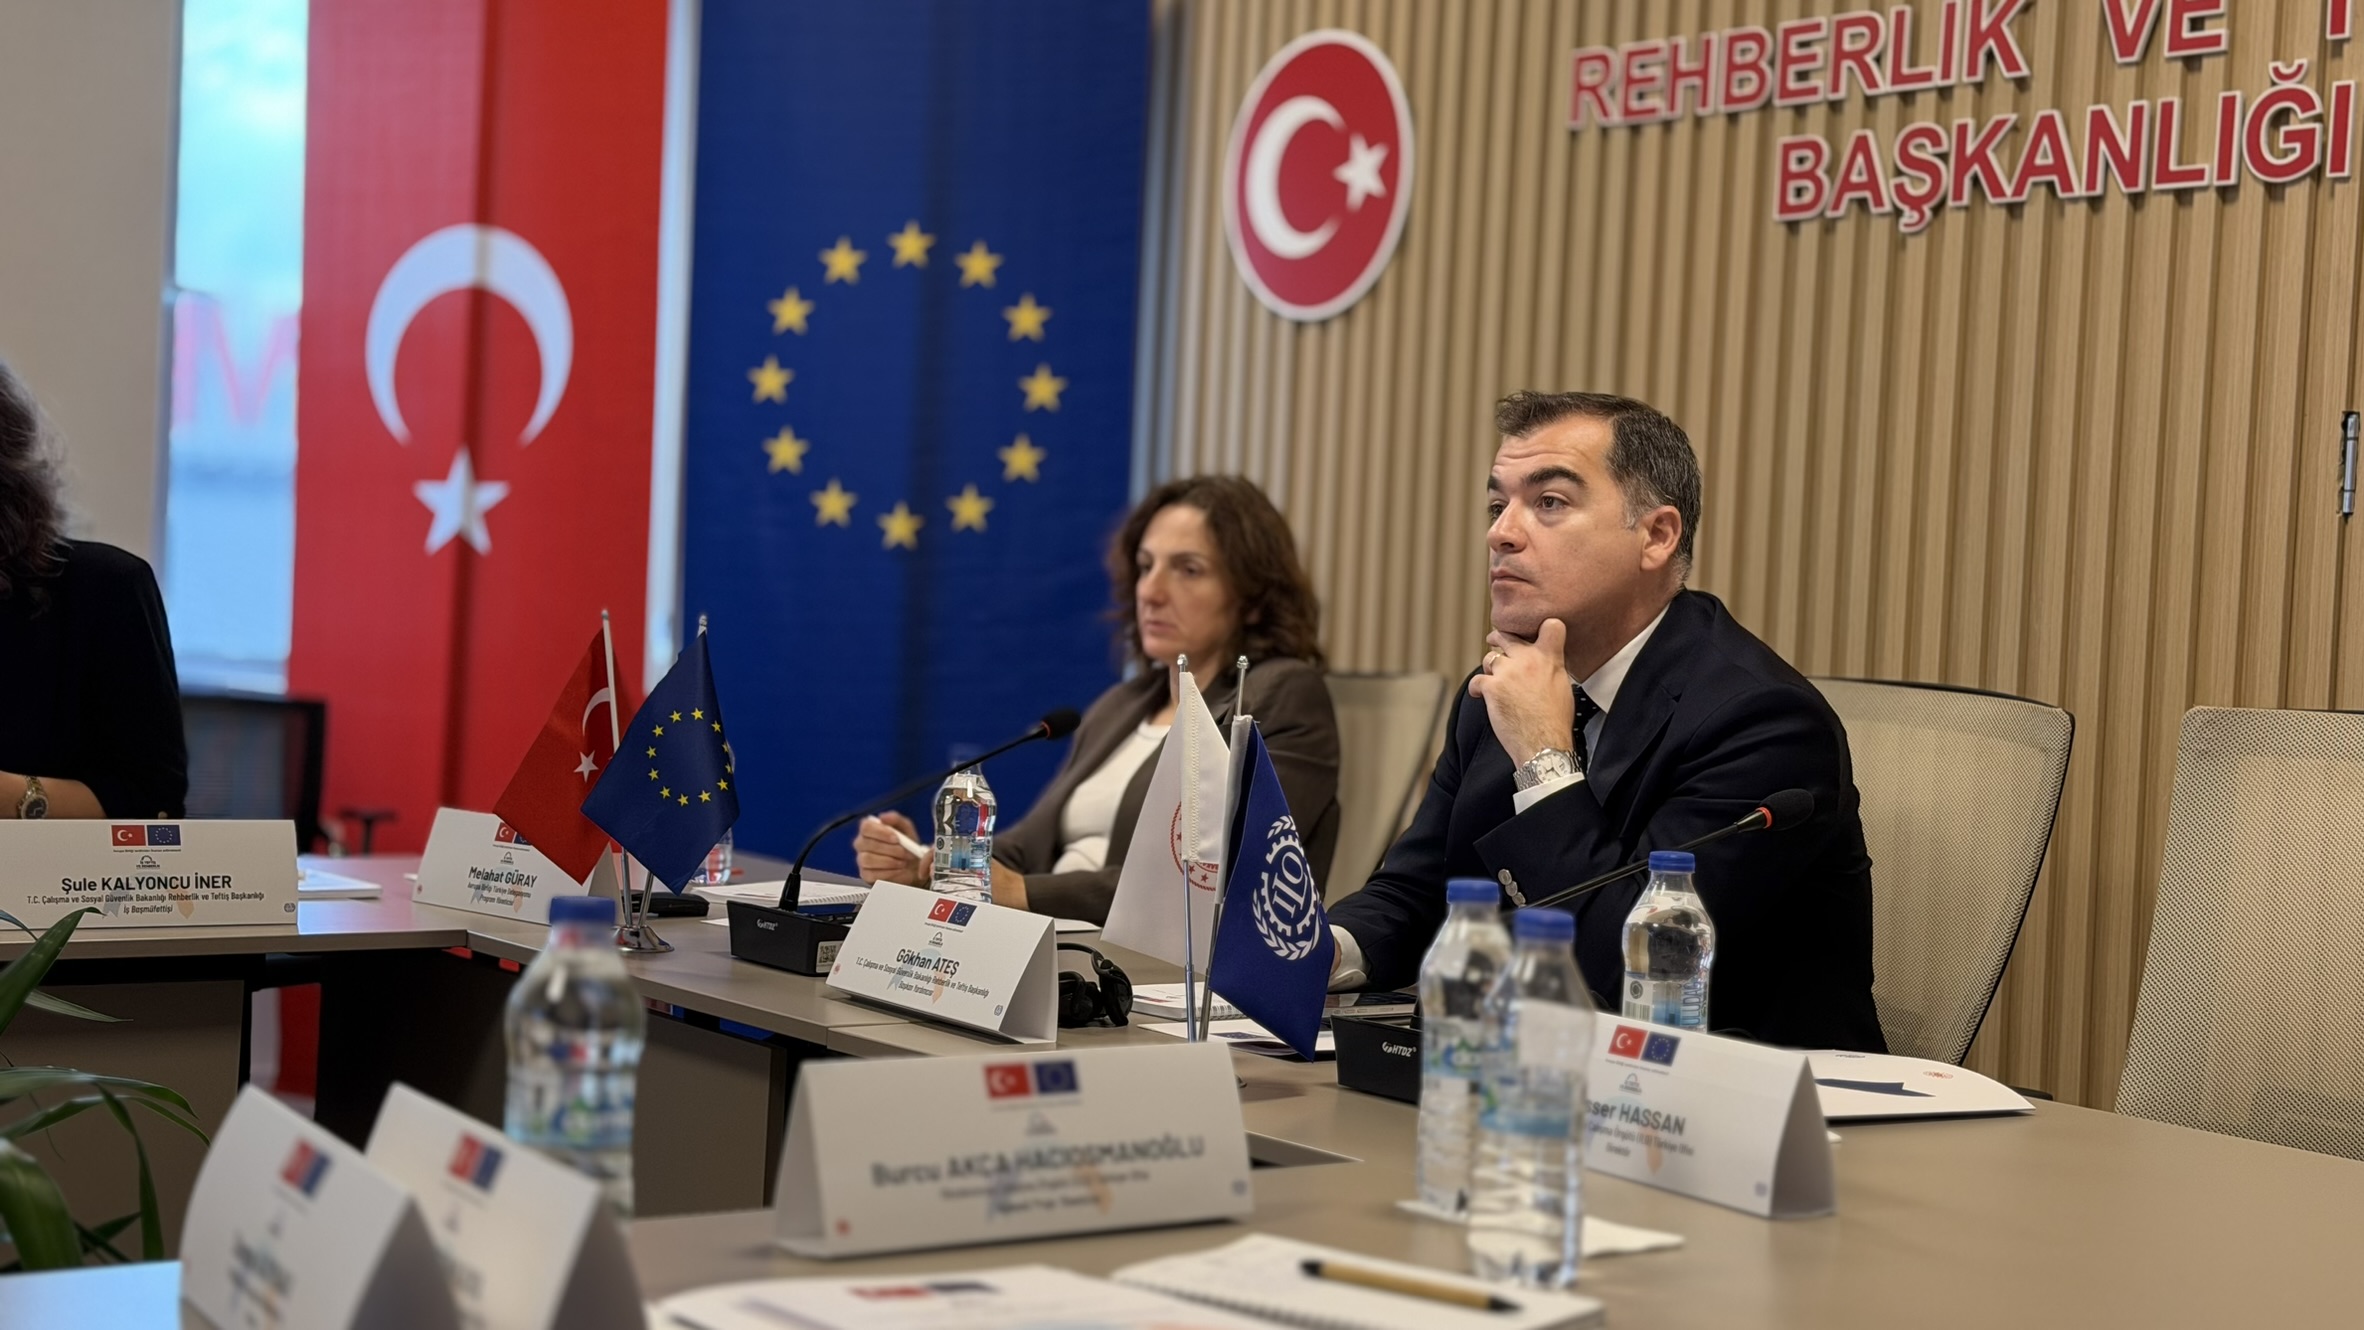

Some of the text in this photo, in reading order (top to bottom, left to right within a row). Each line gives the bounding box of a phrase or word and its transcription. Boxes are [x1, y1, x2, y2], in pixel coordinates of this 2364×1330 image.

[1773, 58, 2355, 232] BAŞKANLIĞI
[61, 872, 232, 895] Şule KALYONCU İNER
[468, 866, 538, 888] Melahat GÜRAY
[1272, 851, 1308, 919] ILO
[27, 891, 264, 905] T.C. Çalışma ve Sosyal Güvenlik Bakanlığı Rehberlik ve Teftiş Başkanlığı
[123, 904, 173, 915] İş Başmüfettişi
[896, 948, 960, 978] Gökhan ATEŞ
[1584, 1098, 1686, 1137] sser HASSAN
[870, 1161, 942, 1188] Burcu
[946, 1152, 1006, 1182] AKÇA
